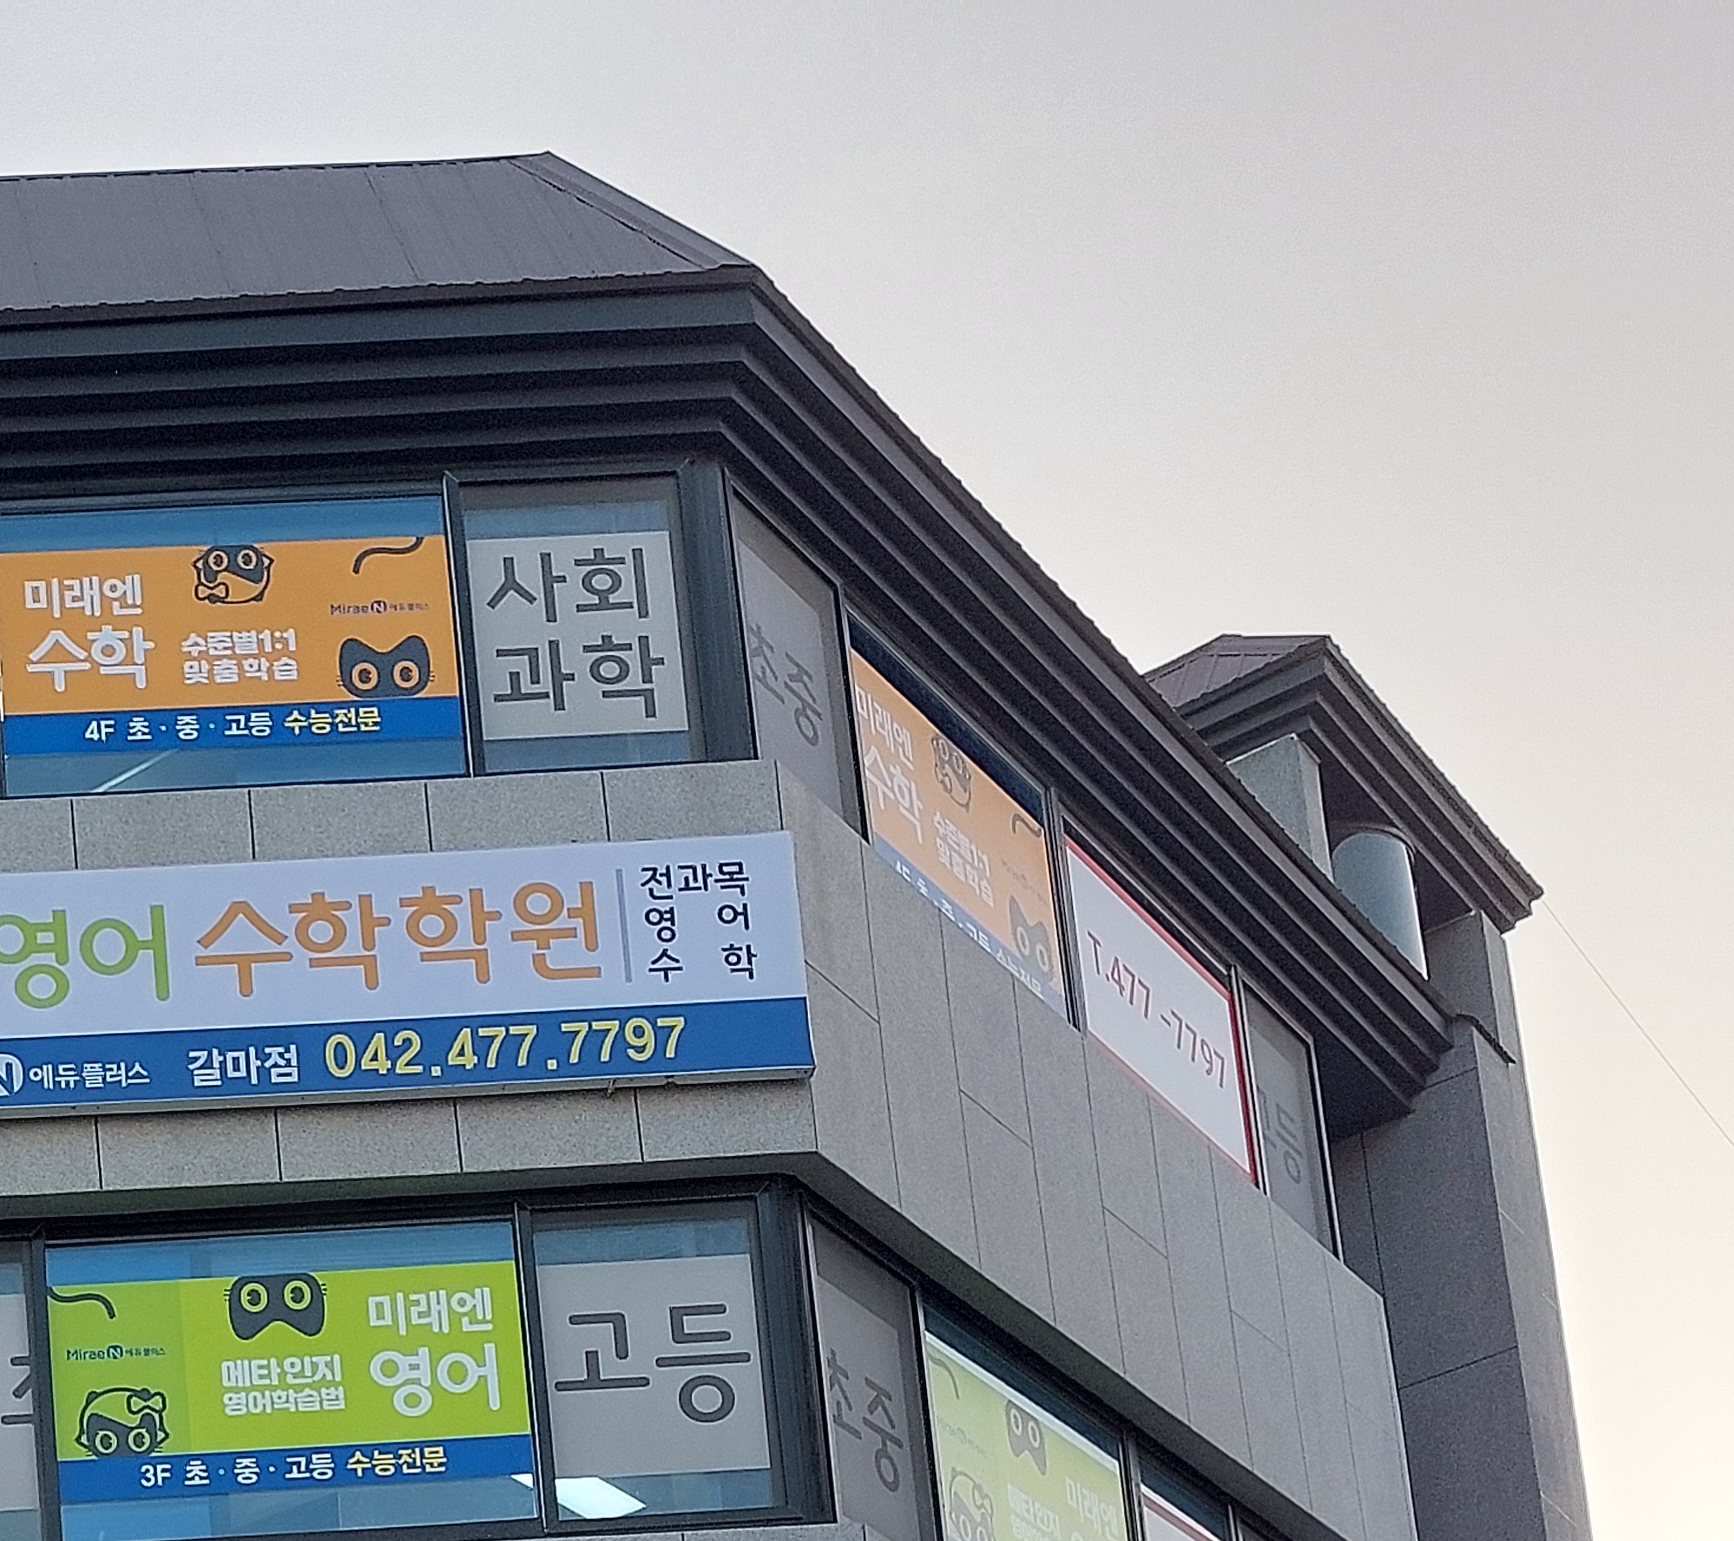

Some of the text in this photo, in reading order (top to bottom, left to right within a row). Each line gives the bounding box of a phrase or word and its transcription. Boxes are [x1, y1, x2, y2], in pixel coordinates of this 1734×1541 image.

[23, 573, 143, 618] 미래엔
[486, 546, 652, 623] 사회
[26, 623, 155, 692] 수학
[183, 655, 299, 685] 맞춤학습
[493, 633, 666, 719] 과학
[749, 620, 824, 748] 초중
[84, 707, 381, 743] 4F 수능전문
[856, 685, 914, 770] 미래엔
[864, 746, 923, 845] 수학
[640, 860, 751, 902] 전과목
[194, 880, 603, 998] 수학학원
[29, 1060, 151, 1091] 에듀플러스
[187, 1044, 299, 1088] 갈마점
[324, 1015, 686, 1078] 042.477.7797
[369, 1286, 494, 1336] 미래엔
[221, 1353, 342, 1389] 메타인지
[223, 1385, 346, 1417] 영어학습법
[369, 1341, 501, 1418] 영어
[554, 1303, 752, 1424] 고등
[826, 1347, 904, 1494] 초중
[139, 1446, 448, 1487] 3F 수능전문
